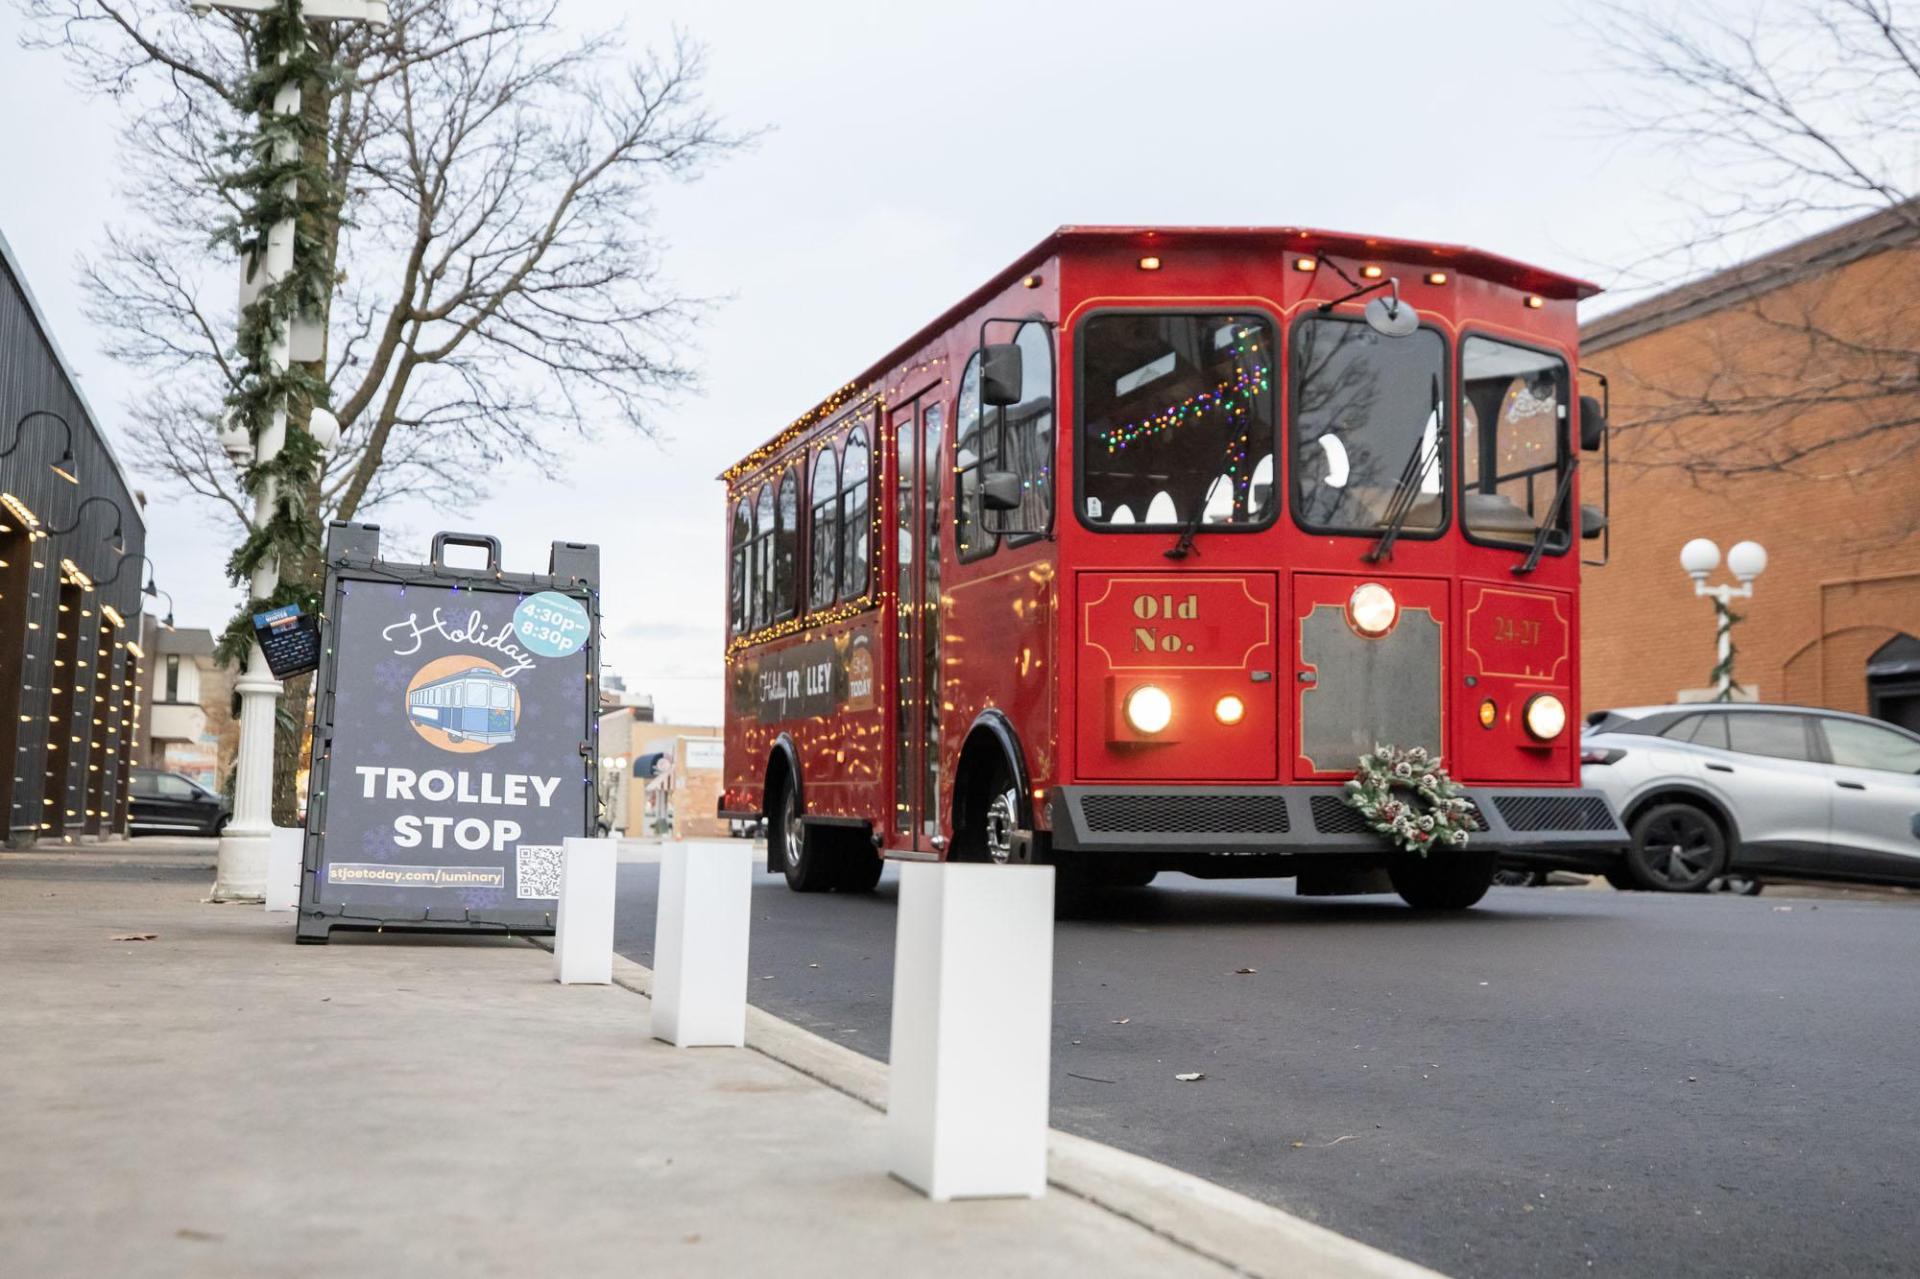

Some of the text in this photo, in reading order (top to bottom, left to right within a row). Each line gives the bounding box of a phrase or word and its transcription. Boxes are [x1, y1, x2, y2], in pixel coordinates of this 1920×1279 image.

[1133, 595, 1198, 619] Old
[382, 607, 537, 678] Holiday
[521, 620, 574, 651] 8:30p
[1134, 628, 1196, 652] No.
[355, 766, 562, 807] TROLLEY
[393, 814, 522, 851] STOP
[330, 867, 502, 886] stjoetoday.com/luminary
